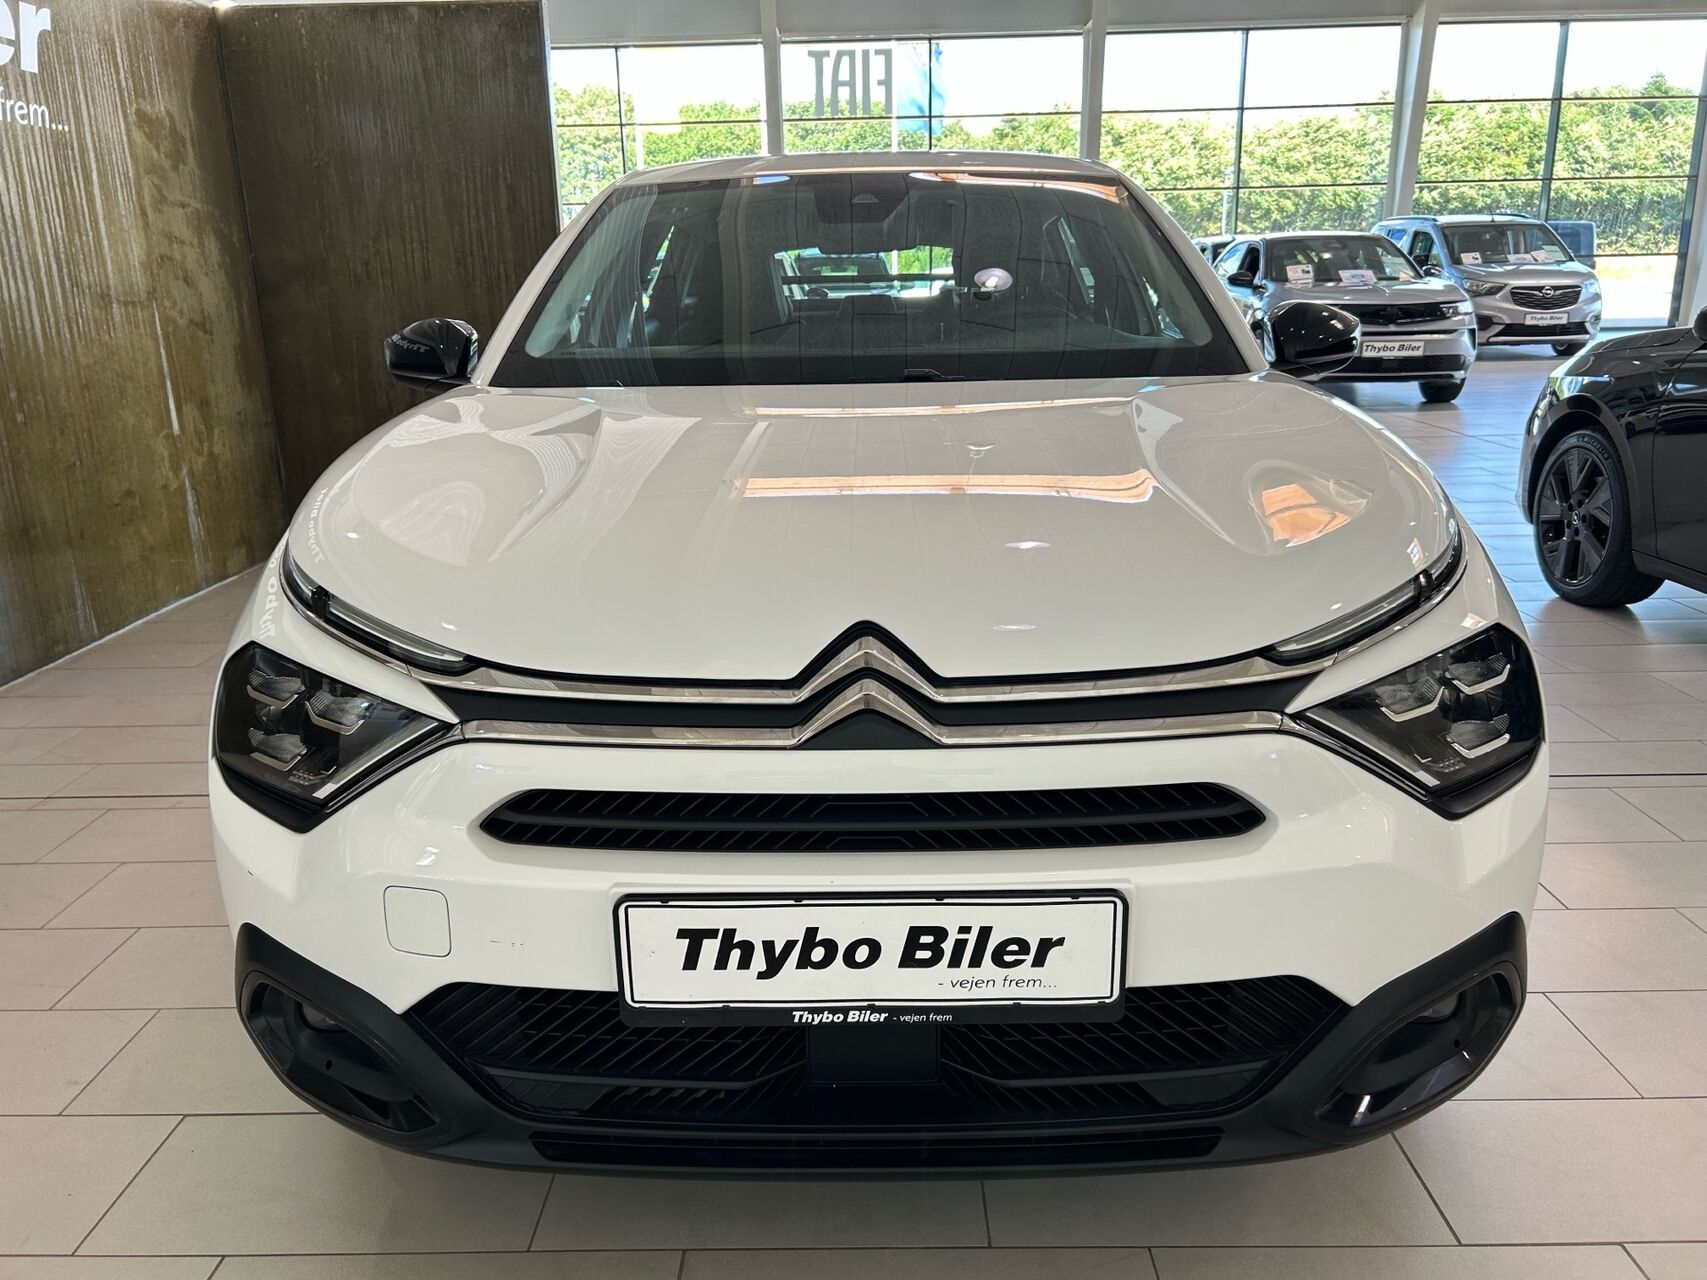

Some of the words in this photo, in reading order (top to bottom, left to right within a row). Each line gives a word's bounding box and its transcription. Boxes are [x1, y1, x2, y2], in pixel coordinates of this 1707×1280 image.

[1364, 344, 1395, 353] Thybo
[1397, 343, 1422, 352] Biler
[675, 926, 882, 980] Thybo
[897, 925, 1066, 969] Biler
[950, 976, 996, 992] vejen
[1002, 975, 1058, 988] frem...
[792, 1011, 845, 1025] Thybo
[846, 1010, 889, 1023] Biler
[899, 1013, 927, 1024] vejen
[929, 1012, 953, 1022] frem
